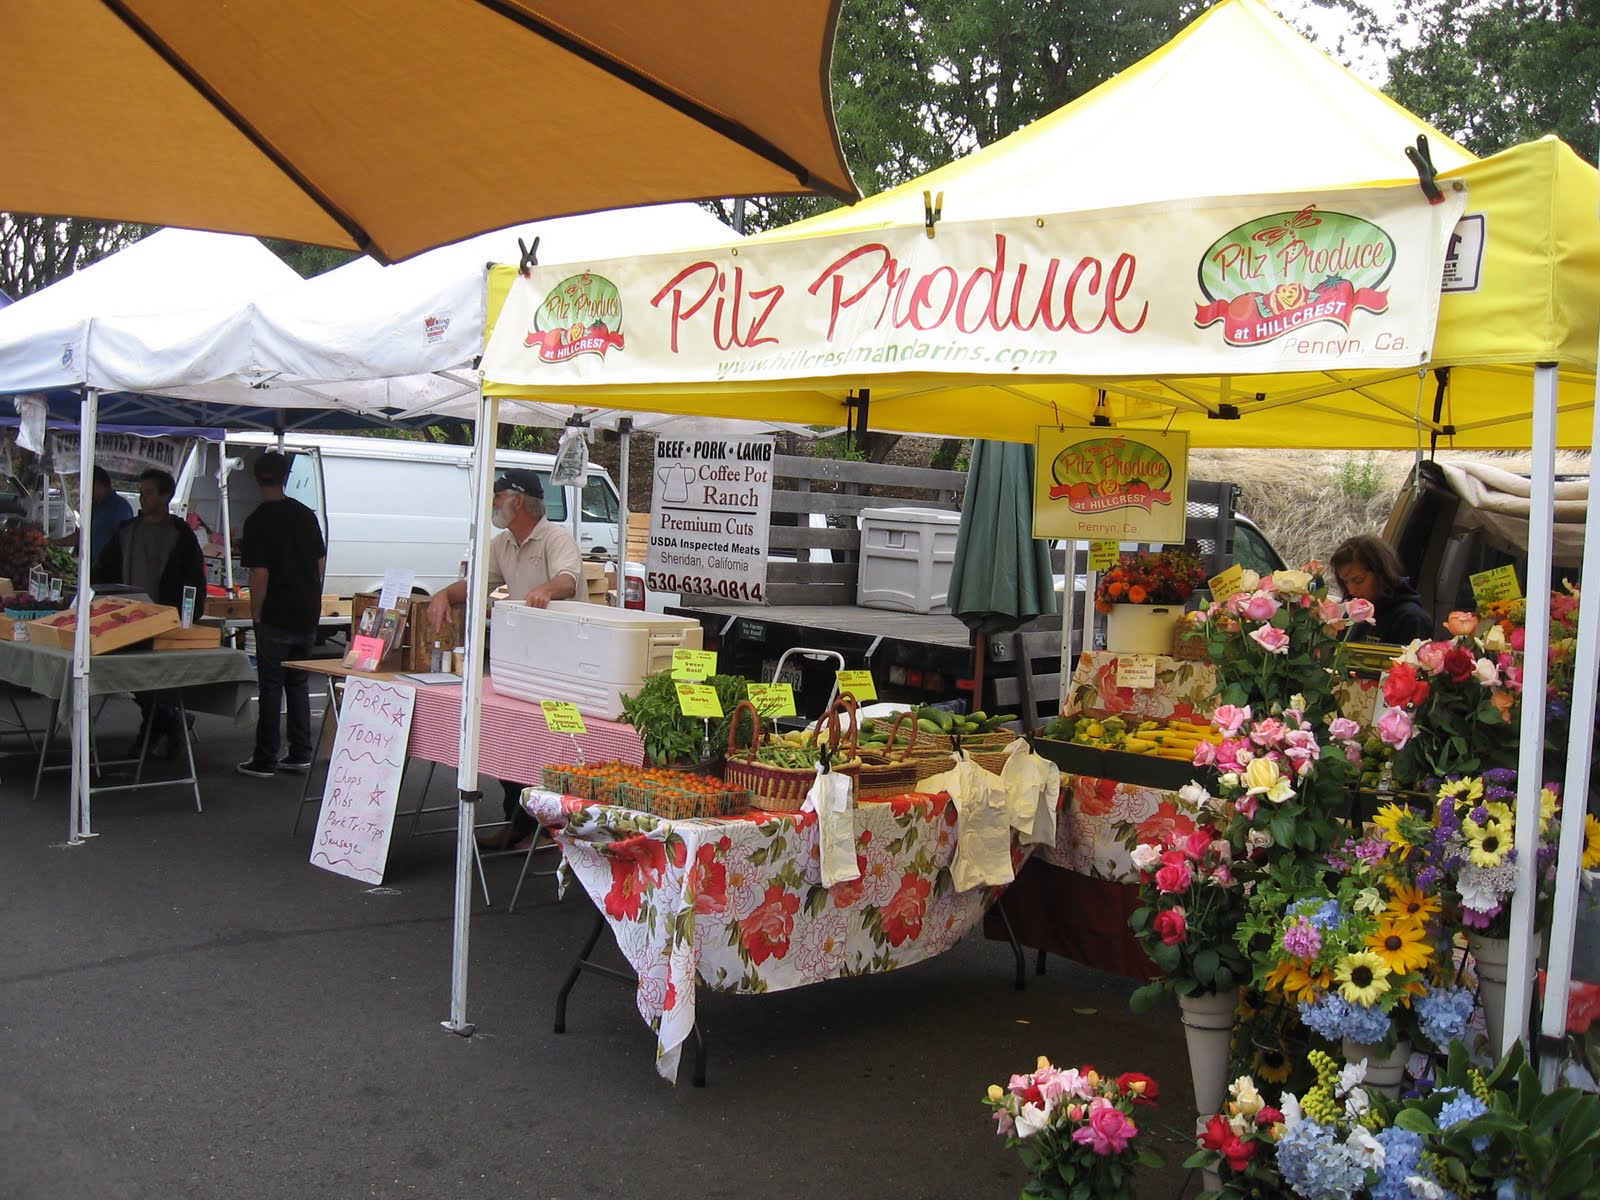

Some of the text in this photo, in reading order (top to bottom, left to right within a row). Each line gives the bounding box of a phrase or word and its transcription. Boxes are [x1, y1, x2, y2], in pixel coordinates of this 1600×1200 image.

[1212, 238, 1386, 281] Pilz Produce
[650, 233, 1149, 353] Pilz Produce
[546, 295, 570, 320] Pilz
[1234, 300, 1346, 340] at HILLCREST
[544, 338, 605, 358] at HILLCREST
[1283, 333, 1409, 356] Penryn, Ca.
[140, 438, 175, 467] FARM
[657, 441, 772, 462] BEEF PORK LAMB
[698, 464, 768, 482] Coffee Pot
[1061, 452, 1167, 478] Pilz Produce
[702, 485, 759, 507] Ranch
[1075, 494, 1146, 510] at HILLCREST
[660, 513, 754, 537] Premium Cuts
[1078, 521, 1119, 534] Penryn,
[650, 536, 761, 556] USDA Inspected Meats
[660, 551, 749, 572] Sheridan, California
[647, 571, 763, 602] 530-633-0814
[350, 690, 391, 717] PORK
[347, 723, 394, 749] TODAY
[333, 766, 363, 786] Chops
[327, 787, 354, 809] Ribs
